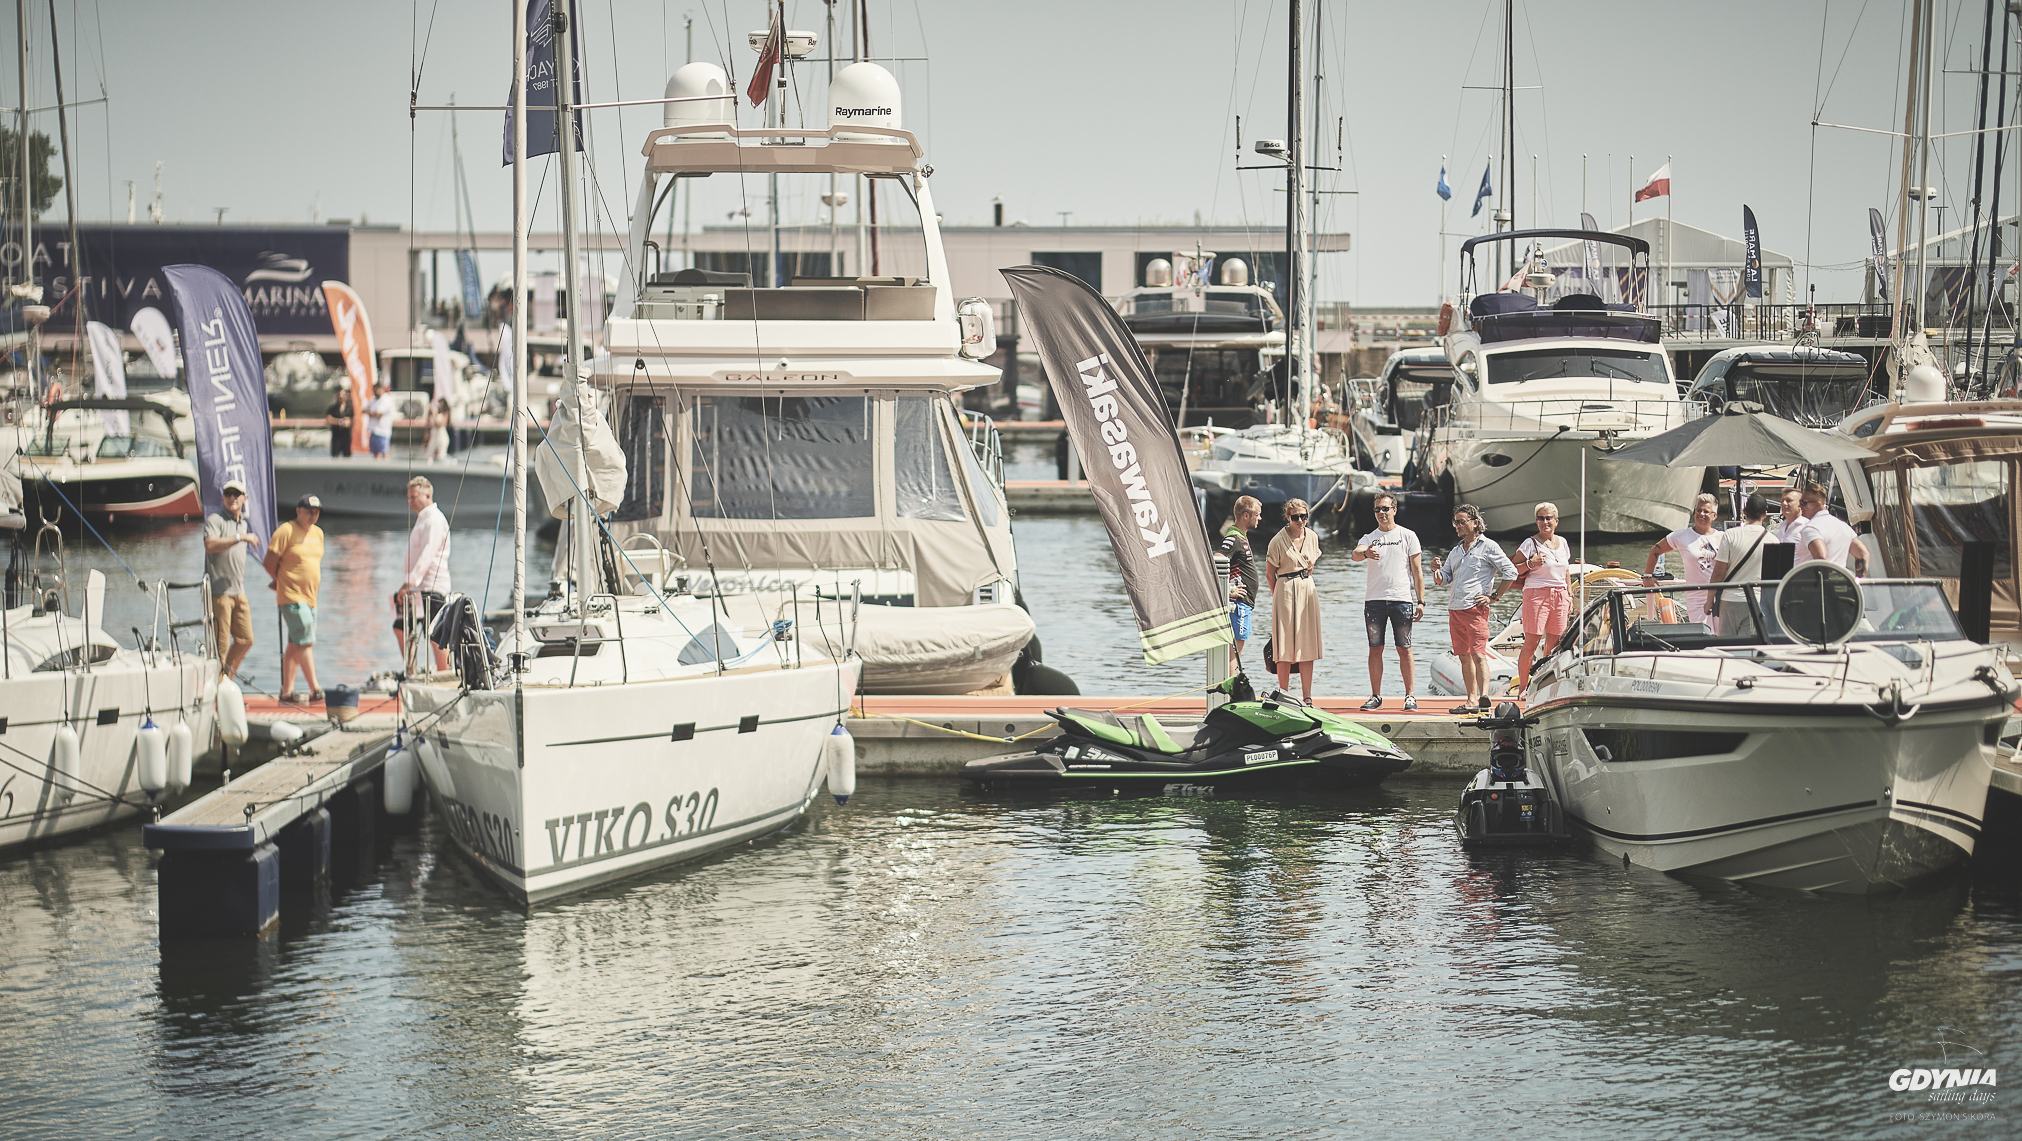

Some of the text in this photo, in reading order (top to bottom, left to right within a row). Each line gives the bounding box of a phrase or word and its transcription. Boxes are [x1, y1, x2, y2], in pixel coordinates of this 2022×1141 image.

[835, 105, 892, 119] Raymarine
[725, 373, 838, 382] GALEON
[686, 572, 803, 595] Veronica
[545, 786, 719, 865] VIKO S30
